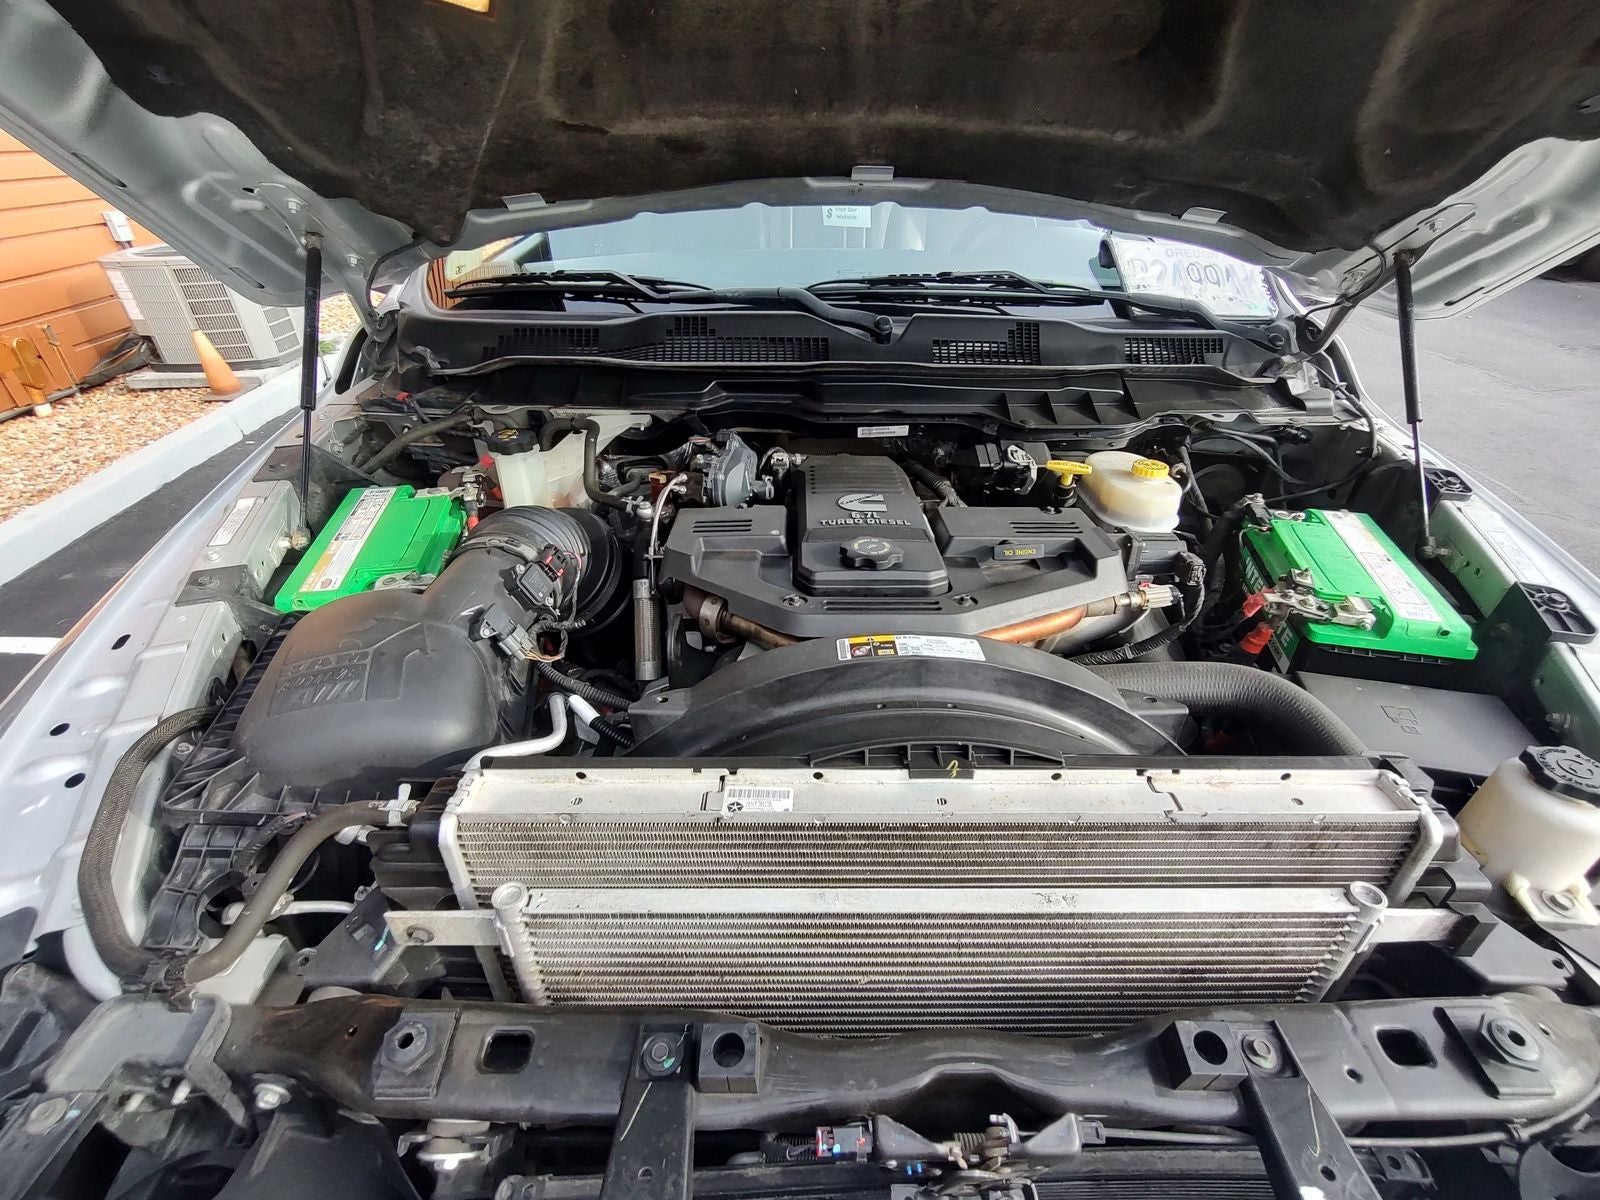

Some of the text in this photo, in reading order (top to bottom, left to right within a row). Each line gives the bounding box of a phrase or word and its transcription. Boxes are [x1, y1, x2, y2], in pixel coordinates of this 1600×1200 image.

[820, 518, 912, 526] TURBO DIESEL
[1014, 548, 1037, 556] ENGINE
